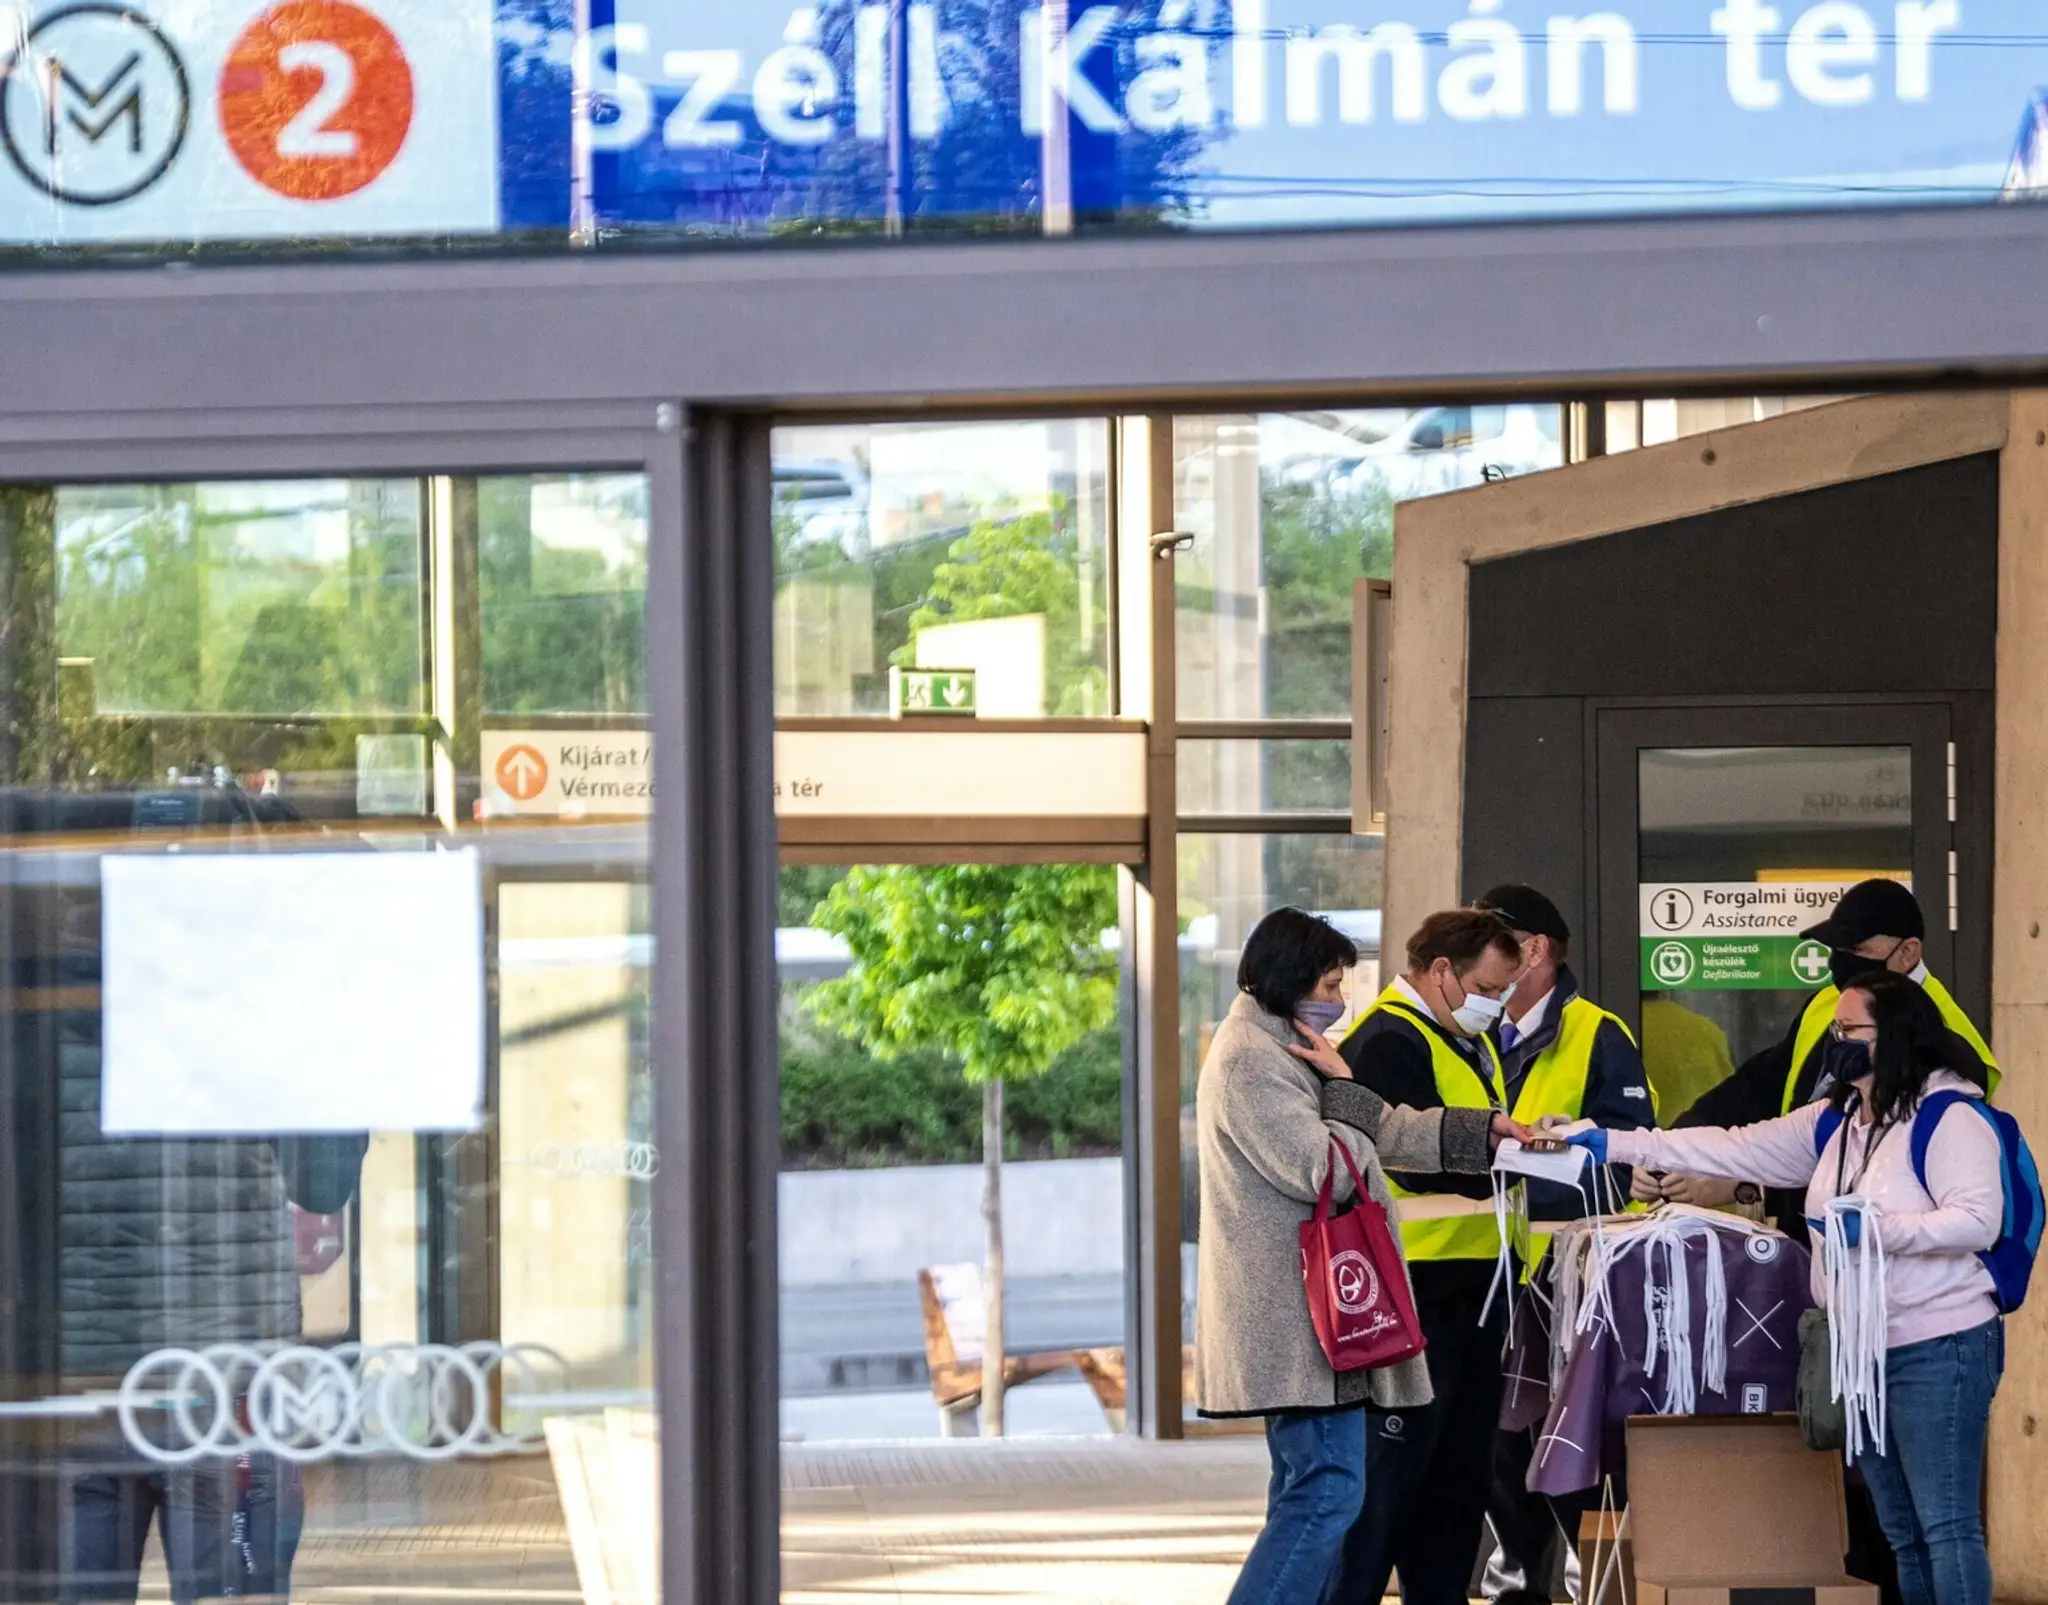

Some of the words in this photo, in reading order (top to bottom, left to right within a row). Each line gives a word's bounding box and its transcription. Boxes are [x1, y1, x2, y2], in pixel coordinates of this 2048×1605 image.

[276, 40, 357, 158] 2
[573, 4, 942, 150] Széll
[1018, 0, 1638, 137] Kálmán
[792, 778, 823, 797] tér
[1703, 889, 1786, 908] Forgalmi
[1794, 887, 1845, 908] ügyel
[1702, 912, 1798, 928] Assistance
